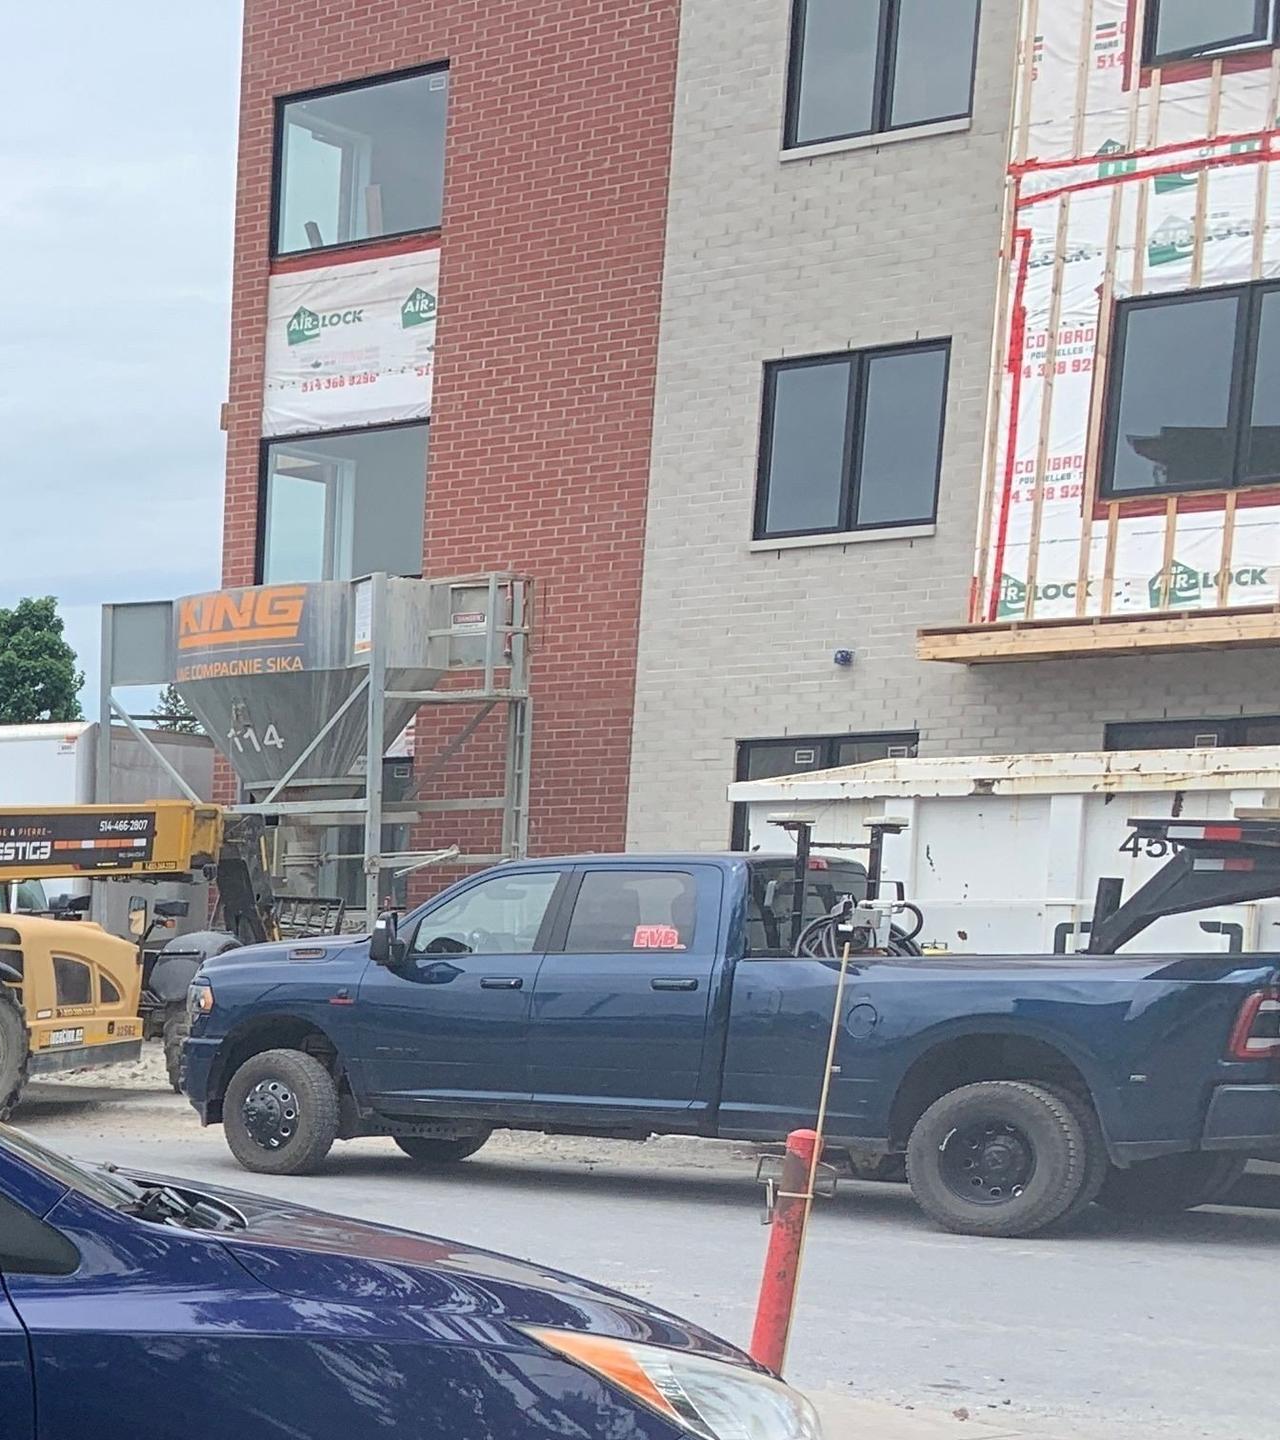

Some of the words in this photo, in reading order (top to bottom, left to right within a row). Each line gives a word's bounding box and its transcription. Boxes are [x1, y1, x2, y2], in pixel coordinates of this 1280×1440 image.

[289, 309, 364, 332] AIR-LOCK
[1026, 328, 1094, 349] COIBRO
[1015, 455, 1082, 475] COIBRO
[178, 585, 307, 633] KING
[191, 657, 263, 679] COMPAGNIE
[266, 656, 305, 672] SIKA
[227, 724, 284, 752] 114
[633, 926, 679, 948] EVB
